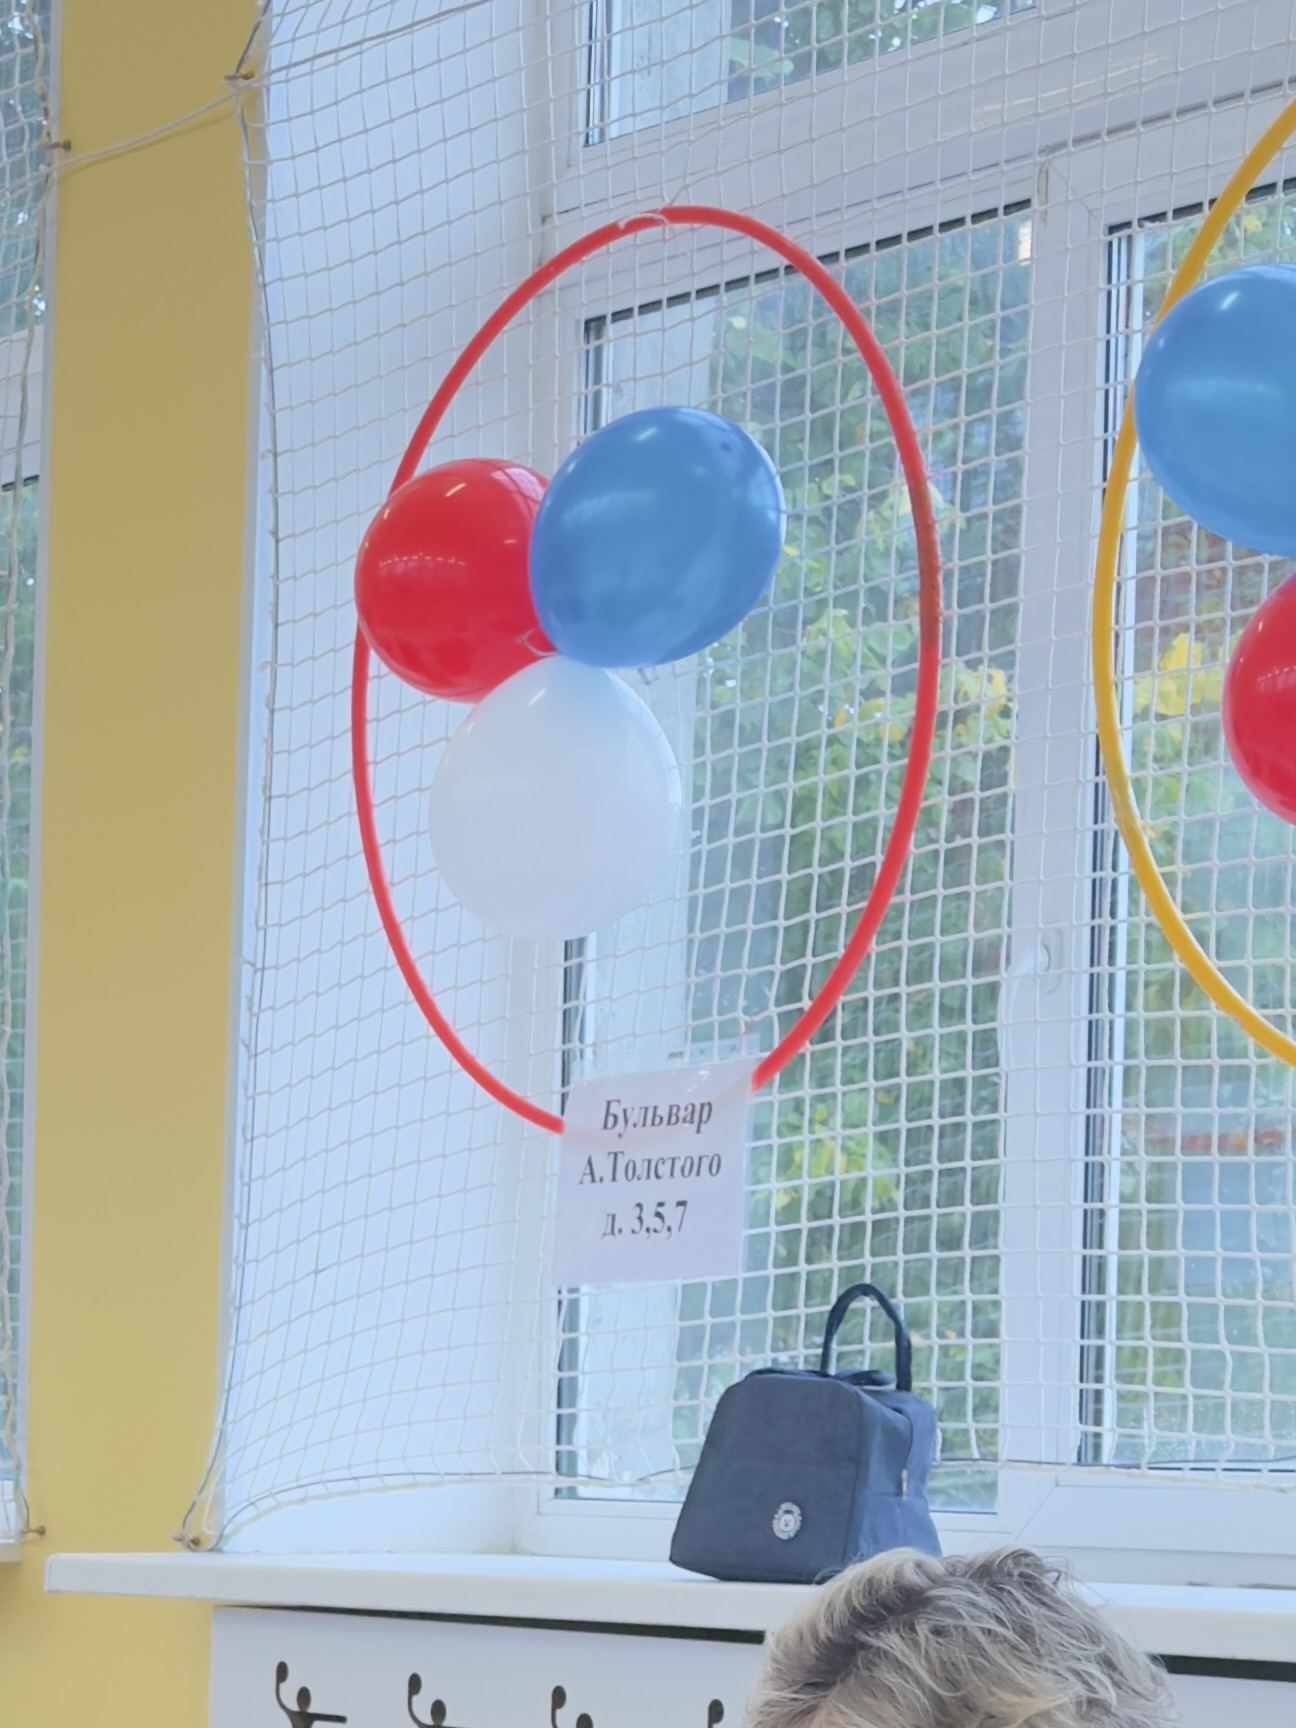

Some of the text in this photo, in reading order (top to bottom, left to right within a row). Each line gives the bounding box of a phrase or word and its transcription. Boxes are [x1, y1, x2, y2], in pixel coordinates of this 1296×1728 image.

[601, 1098, 714, 1138] Бульвар
[578, 1149, 723, 1185] А.Толстого
[601, 1199, 689, 1240] д. 3,5,7
